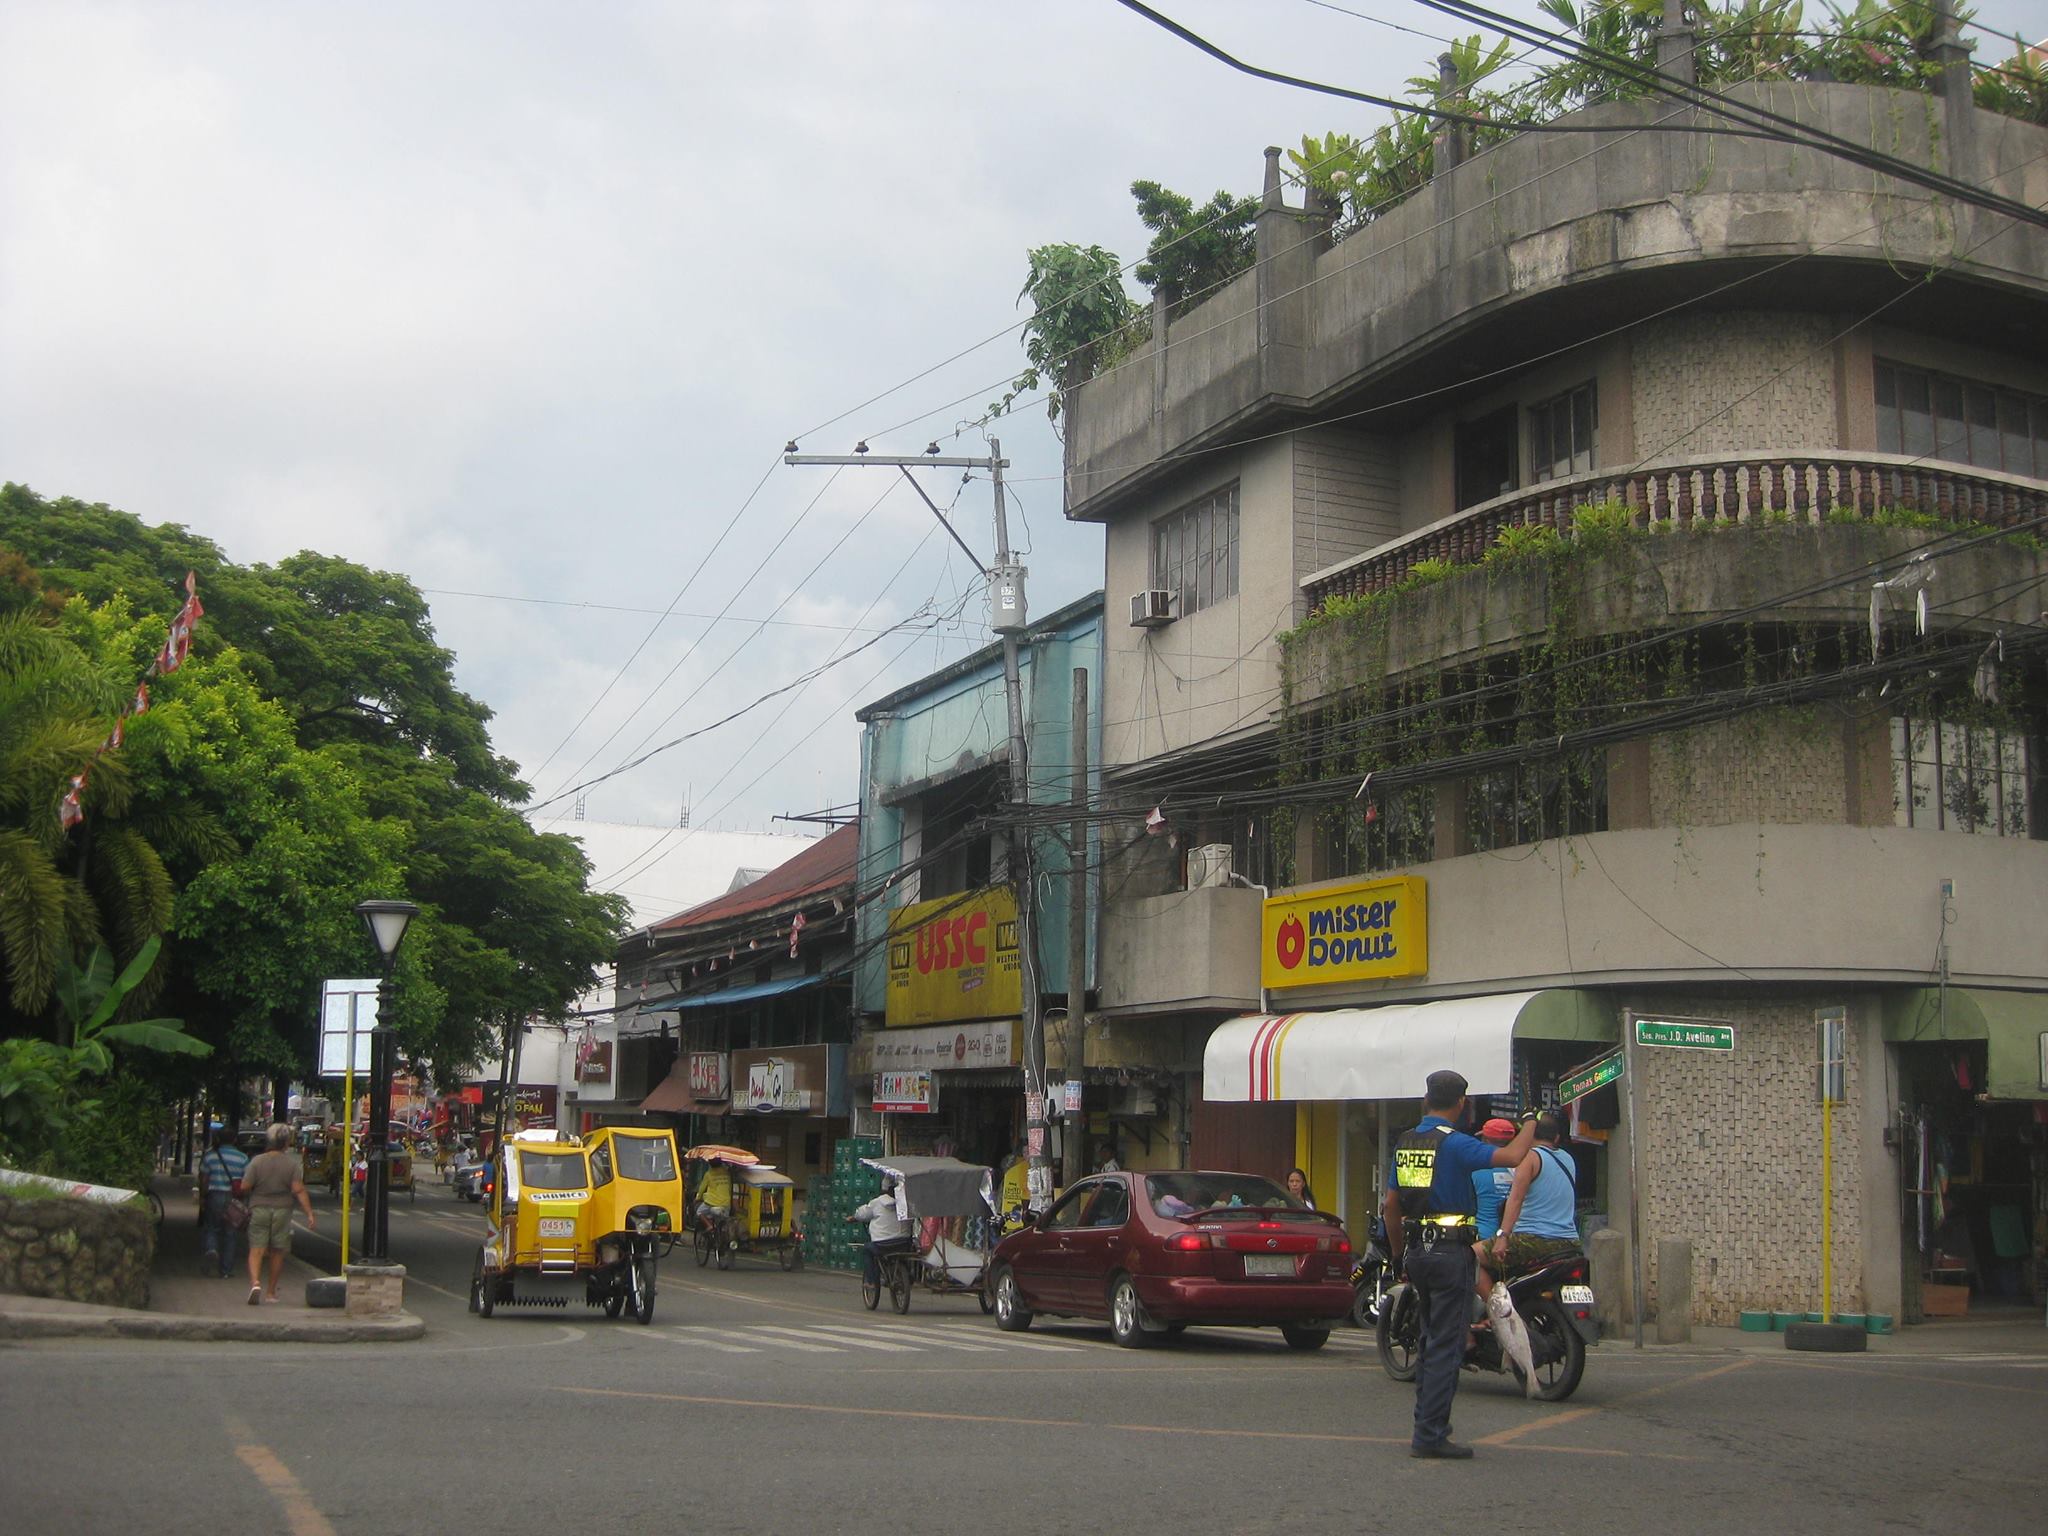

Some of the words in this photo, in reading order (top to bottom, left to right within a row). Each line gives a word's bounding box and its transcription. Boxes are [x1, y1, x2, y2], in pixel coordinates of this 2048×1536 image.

[1309, 900, 1397, 936] Mister
[916, 911, 988, 975] USSC
[1308, 932, 1398, 967] Donut
[1669, 1031, 1683, 1042] J.D.
[1685, 1032, 1715, 1043] Avelino
[1572, 1078, 1593, 1093] Tomas
